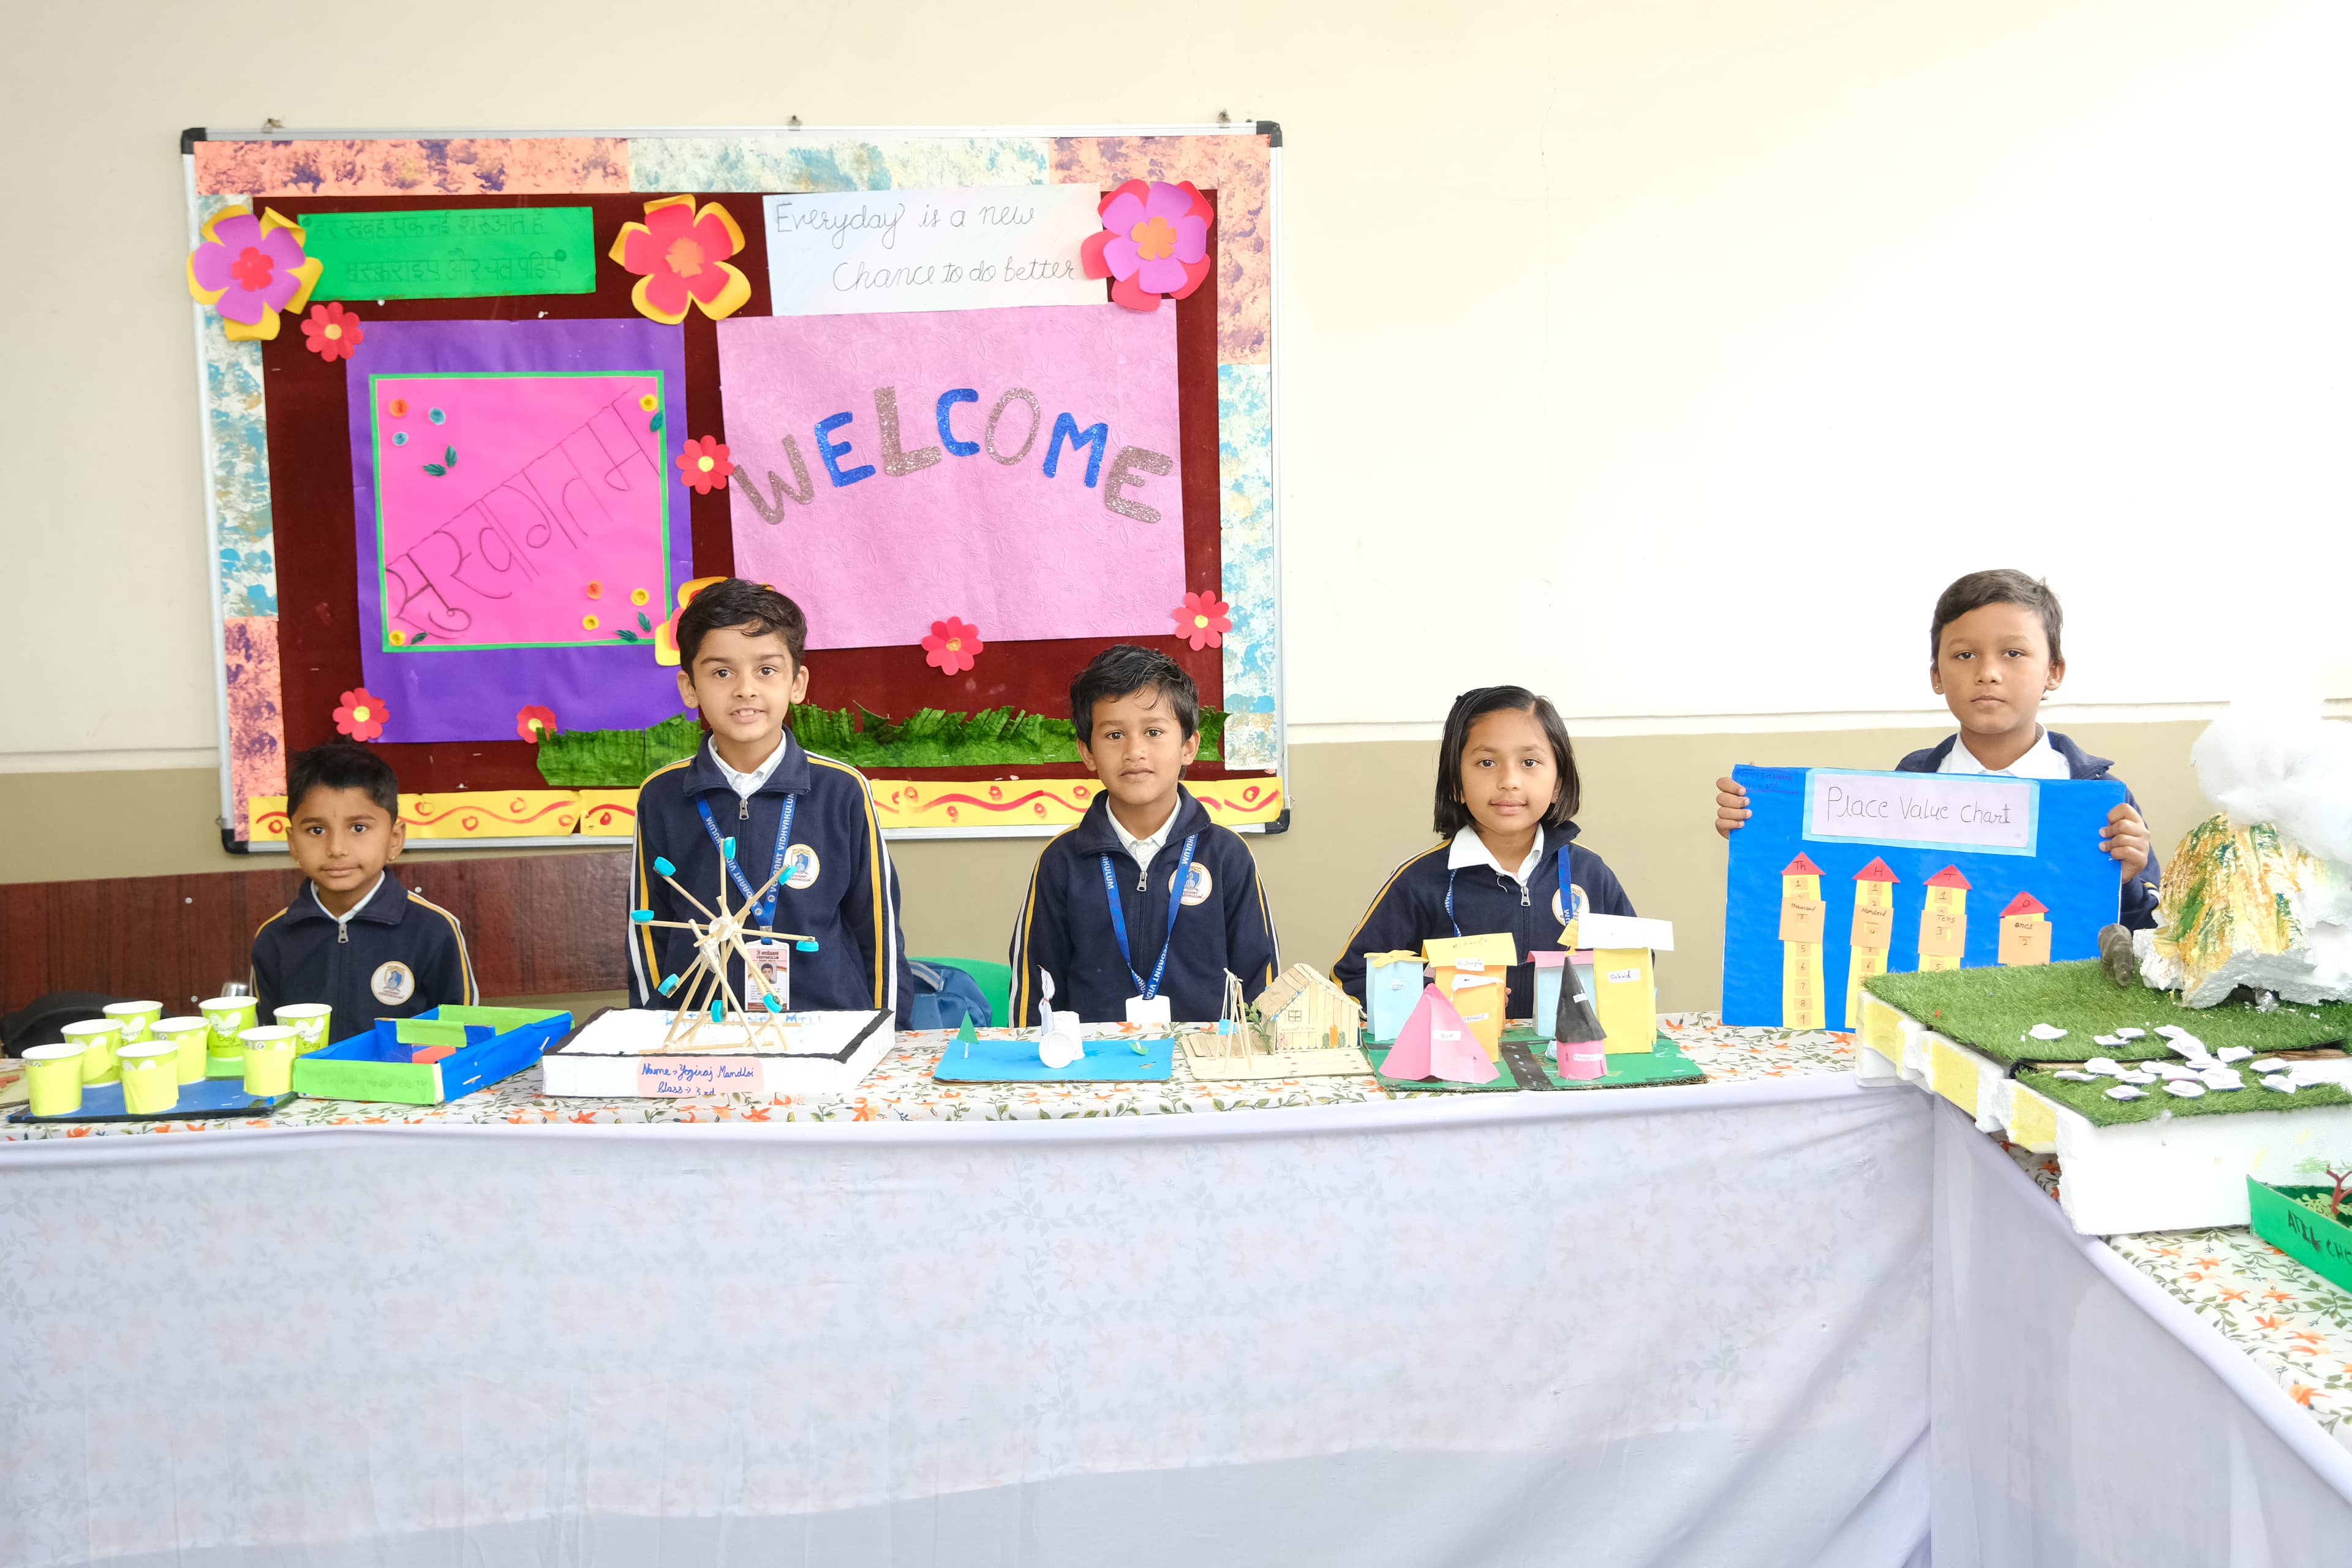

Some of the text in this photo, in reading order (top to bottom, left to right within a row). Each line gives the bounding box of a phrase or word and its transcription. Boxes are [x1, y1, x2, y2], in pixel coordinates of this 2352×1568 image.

[776, 203, 1035, 249] Everyday is a new
[832, 255, 1075, 292] Chance to do better
[734, 386, 1174, 525] WELCOME
[1827, 786, 1888, 822] Place
[1899, 795, 1949, 820] Value
[1793, 860, 1806, 871] Th
[1875, 867, 1883, 877] H
[1936, 927, 1942, 935] 3
[1801, 1015, 1805, 1024] 9
